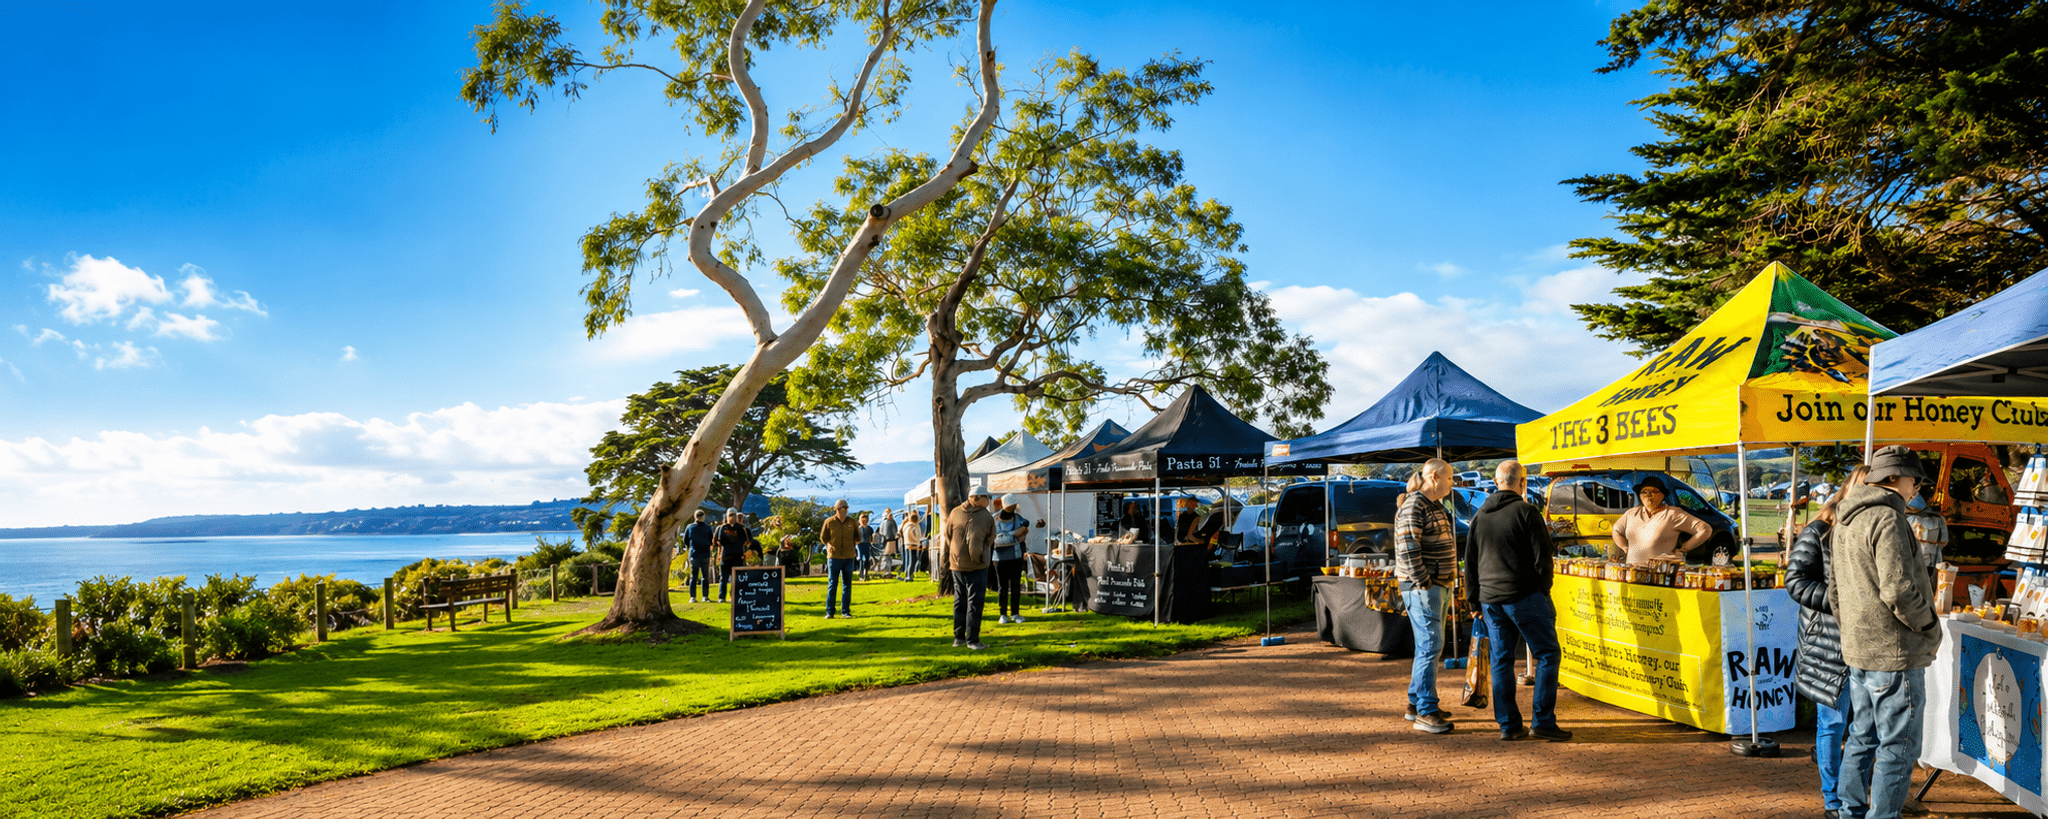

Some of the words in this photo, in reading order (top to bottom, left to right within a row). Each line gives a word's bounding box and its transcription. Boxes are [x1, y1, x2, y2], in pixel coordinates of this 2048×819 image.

[1631, 336, 1752, 382] RAW
[1550, 418, 1592, 450] THE
[1596, 414, 1609, 445] 3
[1615, 404, 1678, 441] BEES
[1776, 393, 1845, 422] Join
[1902, 397, 1984, 430] Honey
[1167, 457, 1203, 470] Pasta
[1209, 456, 1221, 469] 51
[1727, 646, 1797, 682] RAW
[1732, 682, 1794, 711] HONEY
